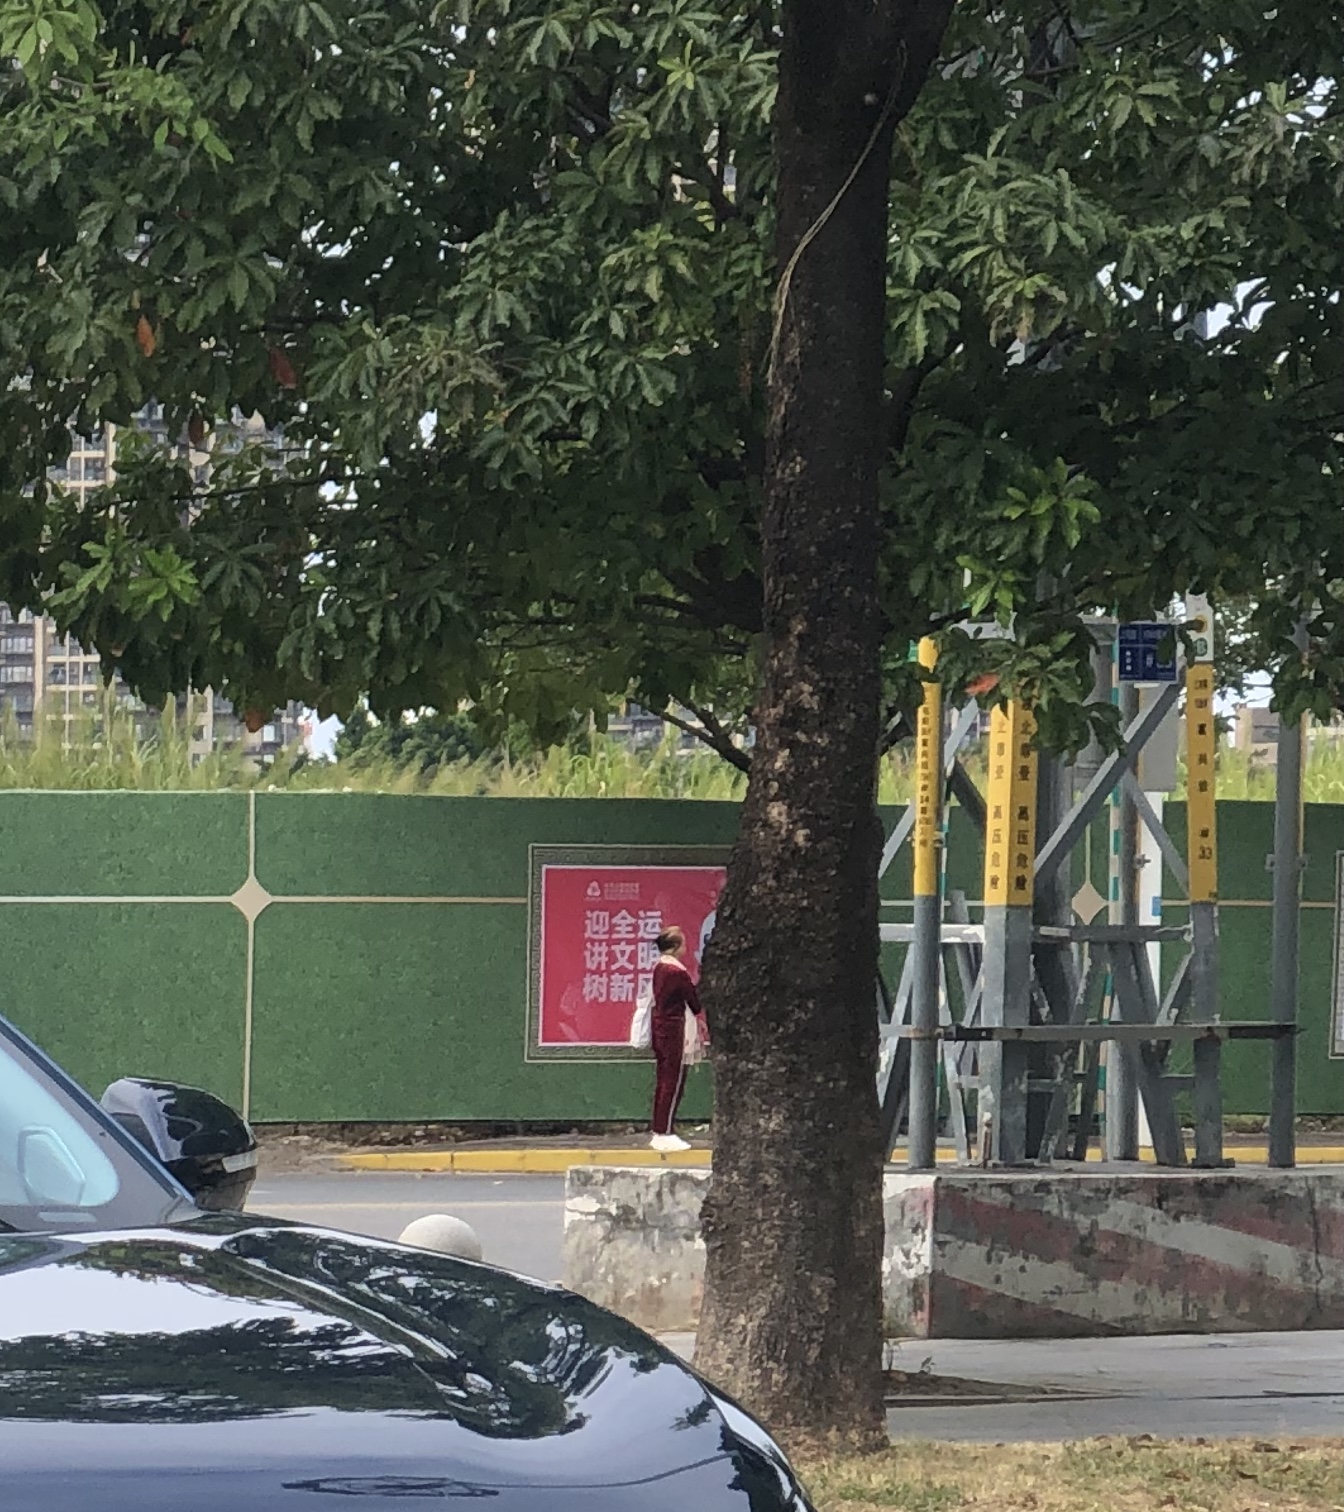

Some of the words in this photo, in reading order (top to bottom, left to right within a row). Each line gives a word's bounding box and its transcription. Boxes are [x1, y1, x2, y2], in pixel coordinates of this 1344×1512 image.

[584, 909, 662, 939] 迎全运
[584, 941, 661, 971] 讲文明
